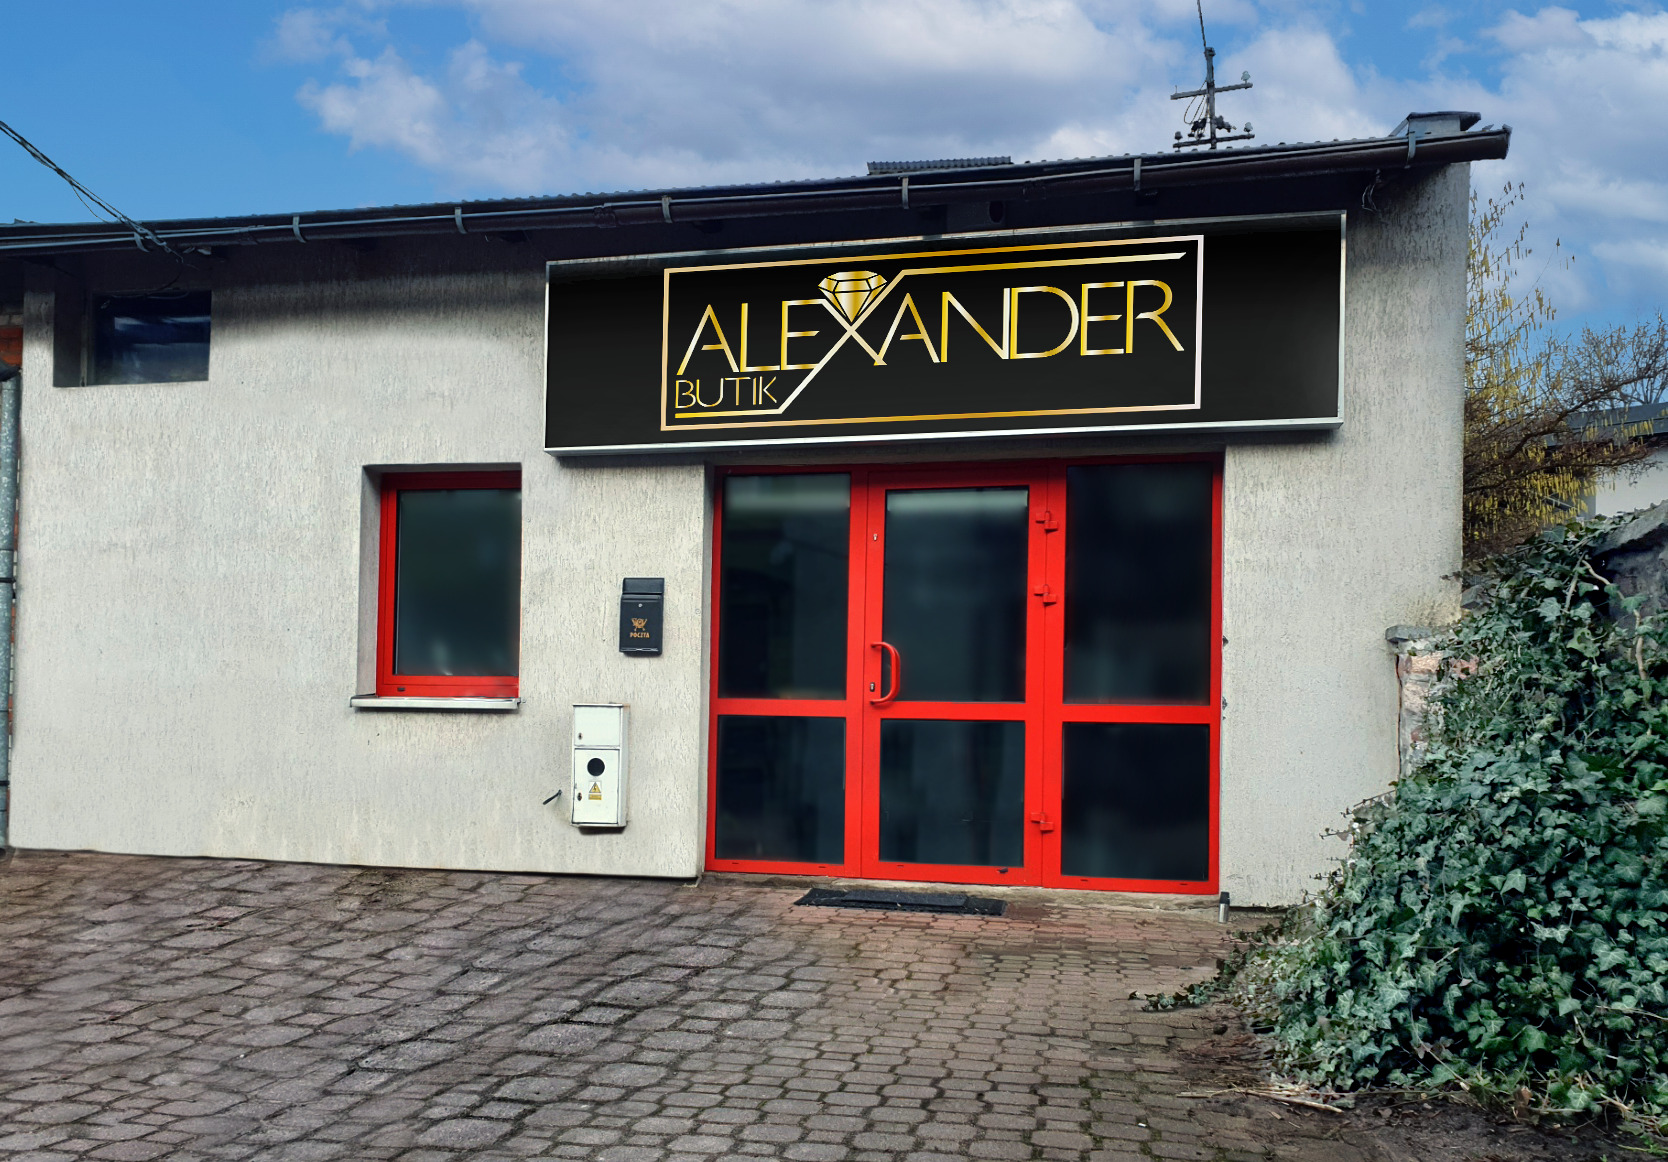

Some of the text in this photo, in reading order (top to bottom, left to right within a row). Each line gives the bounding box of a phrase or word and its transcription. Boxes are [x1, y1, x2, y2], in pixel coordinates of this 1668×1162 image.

[676, 278, 1186, 376] ALEXANDER
[674, 375, 778, 410] BUTIK
[629, 631, 650, 639] POCZTA
